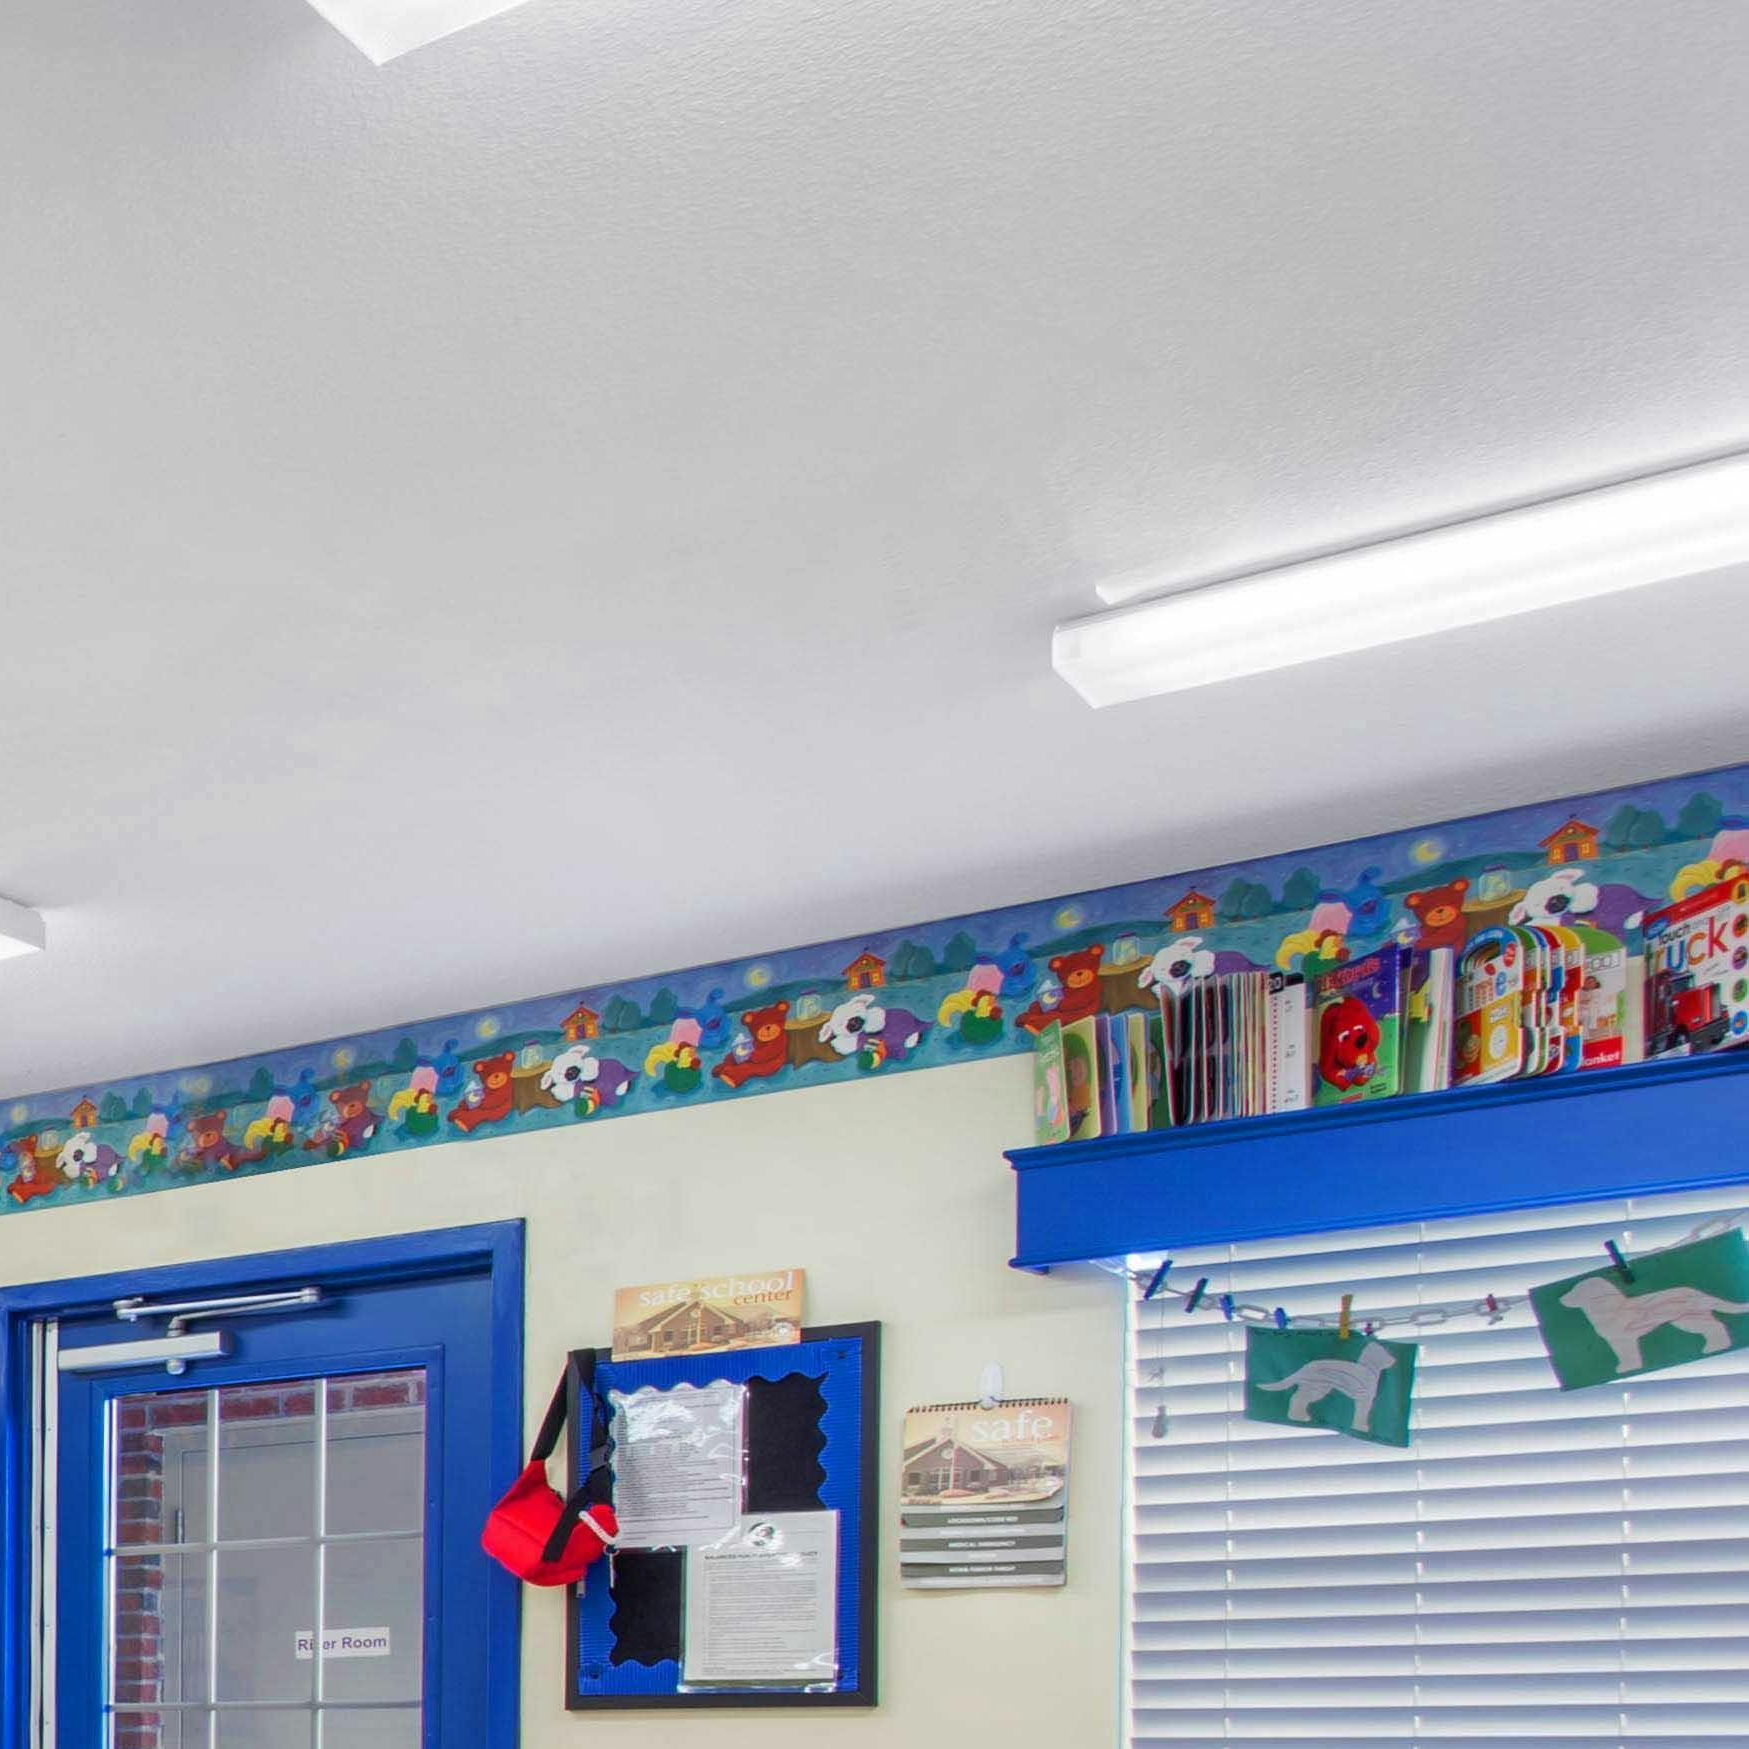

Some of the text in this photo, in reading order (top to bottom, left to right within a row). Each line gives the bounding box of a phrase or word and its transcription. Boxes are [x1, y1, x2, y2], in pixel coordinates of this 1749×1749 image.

[1580, 1050, 1620, 1068] lanket
[639, 1270, 794, 1306] safe school
[733, 1289, 793, 1306] center
[972, 1409, 1054, 1442] safe
[298, 1636, 387, 1651] Rier Room
